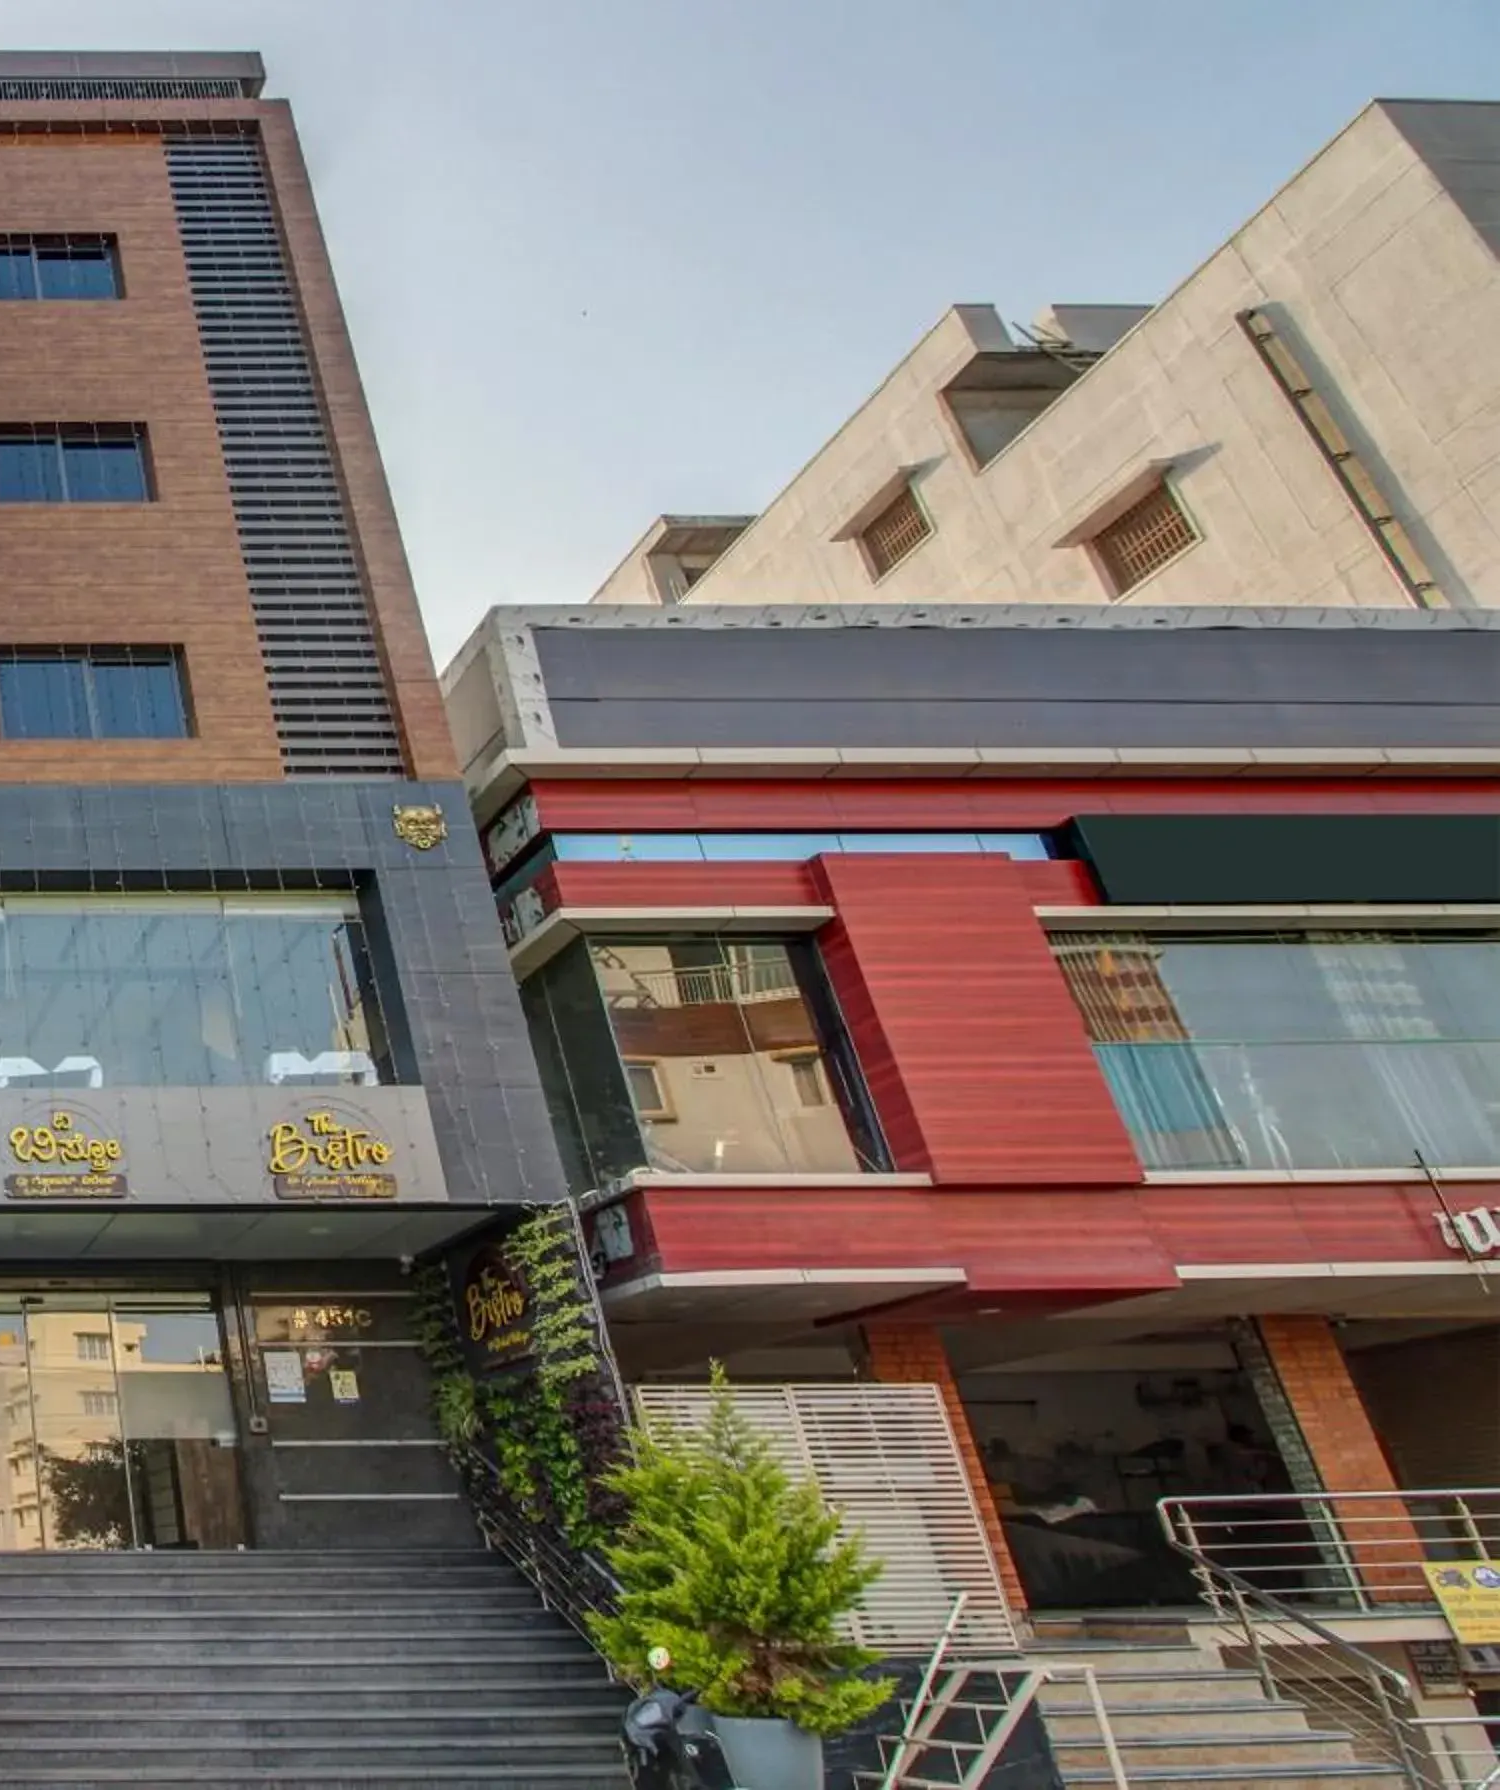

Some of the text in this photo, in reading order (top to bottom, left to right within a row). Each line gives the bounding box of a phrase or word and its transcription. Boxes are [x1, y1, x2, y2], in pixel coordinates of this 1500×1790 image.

[269, 1122, 394, 1173] Bistro
[306, 1111, 343, 1134] The
[466, 1279, 525, 1341] Bistro
